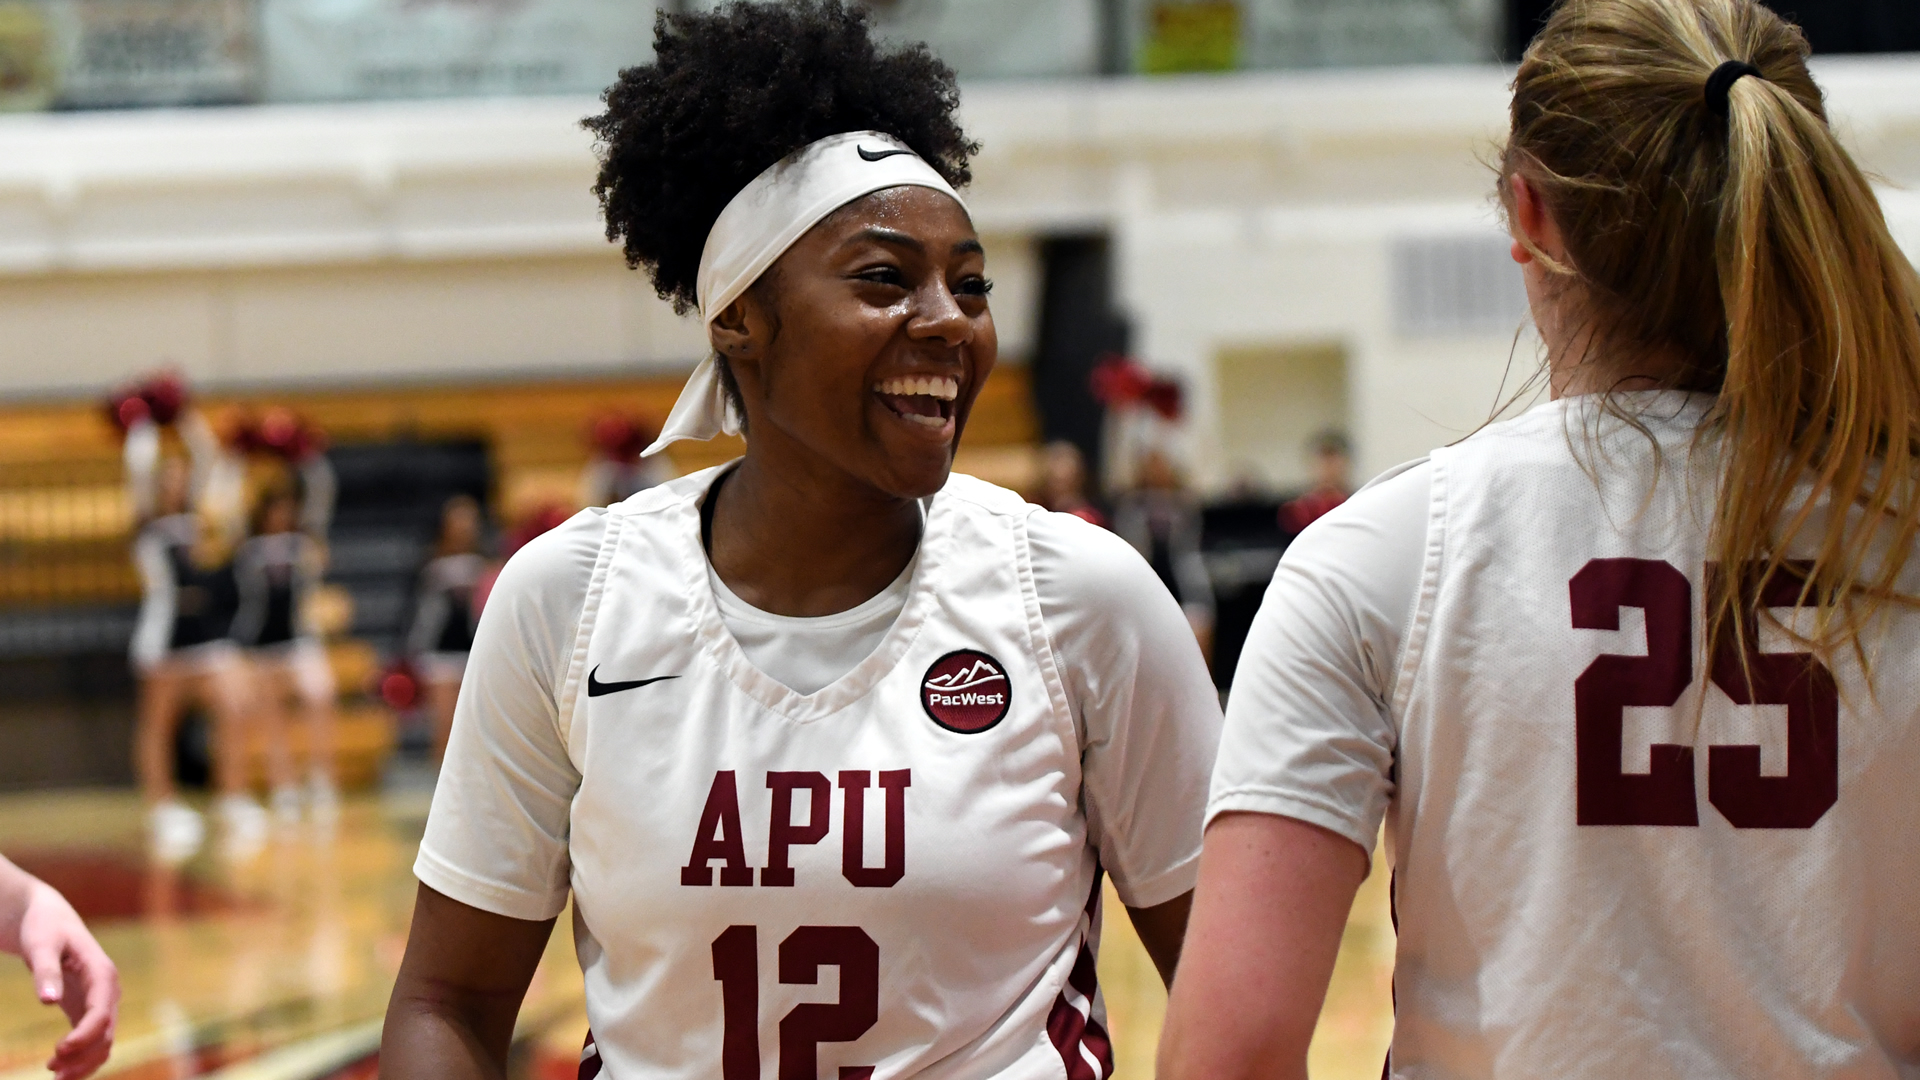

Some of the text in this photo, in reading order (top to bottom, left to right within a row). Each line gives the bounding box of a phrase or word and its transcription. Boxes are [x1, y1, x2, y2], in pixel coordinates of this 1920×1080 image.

[929, 692, 1004, 706] PacWest
[1569, 558, 1839, 829] 25
[680, 768, 912, 887] APU
[711, 924, 880, 1080] 12
